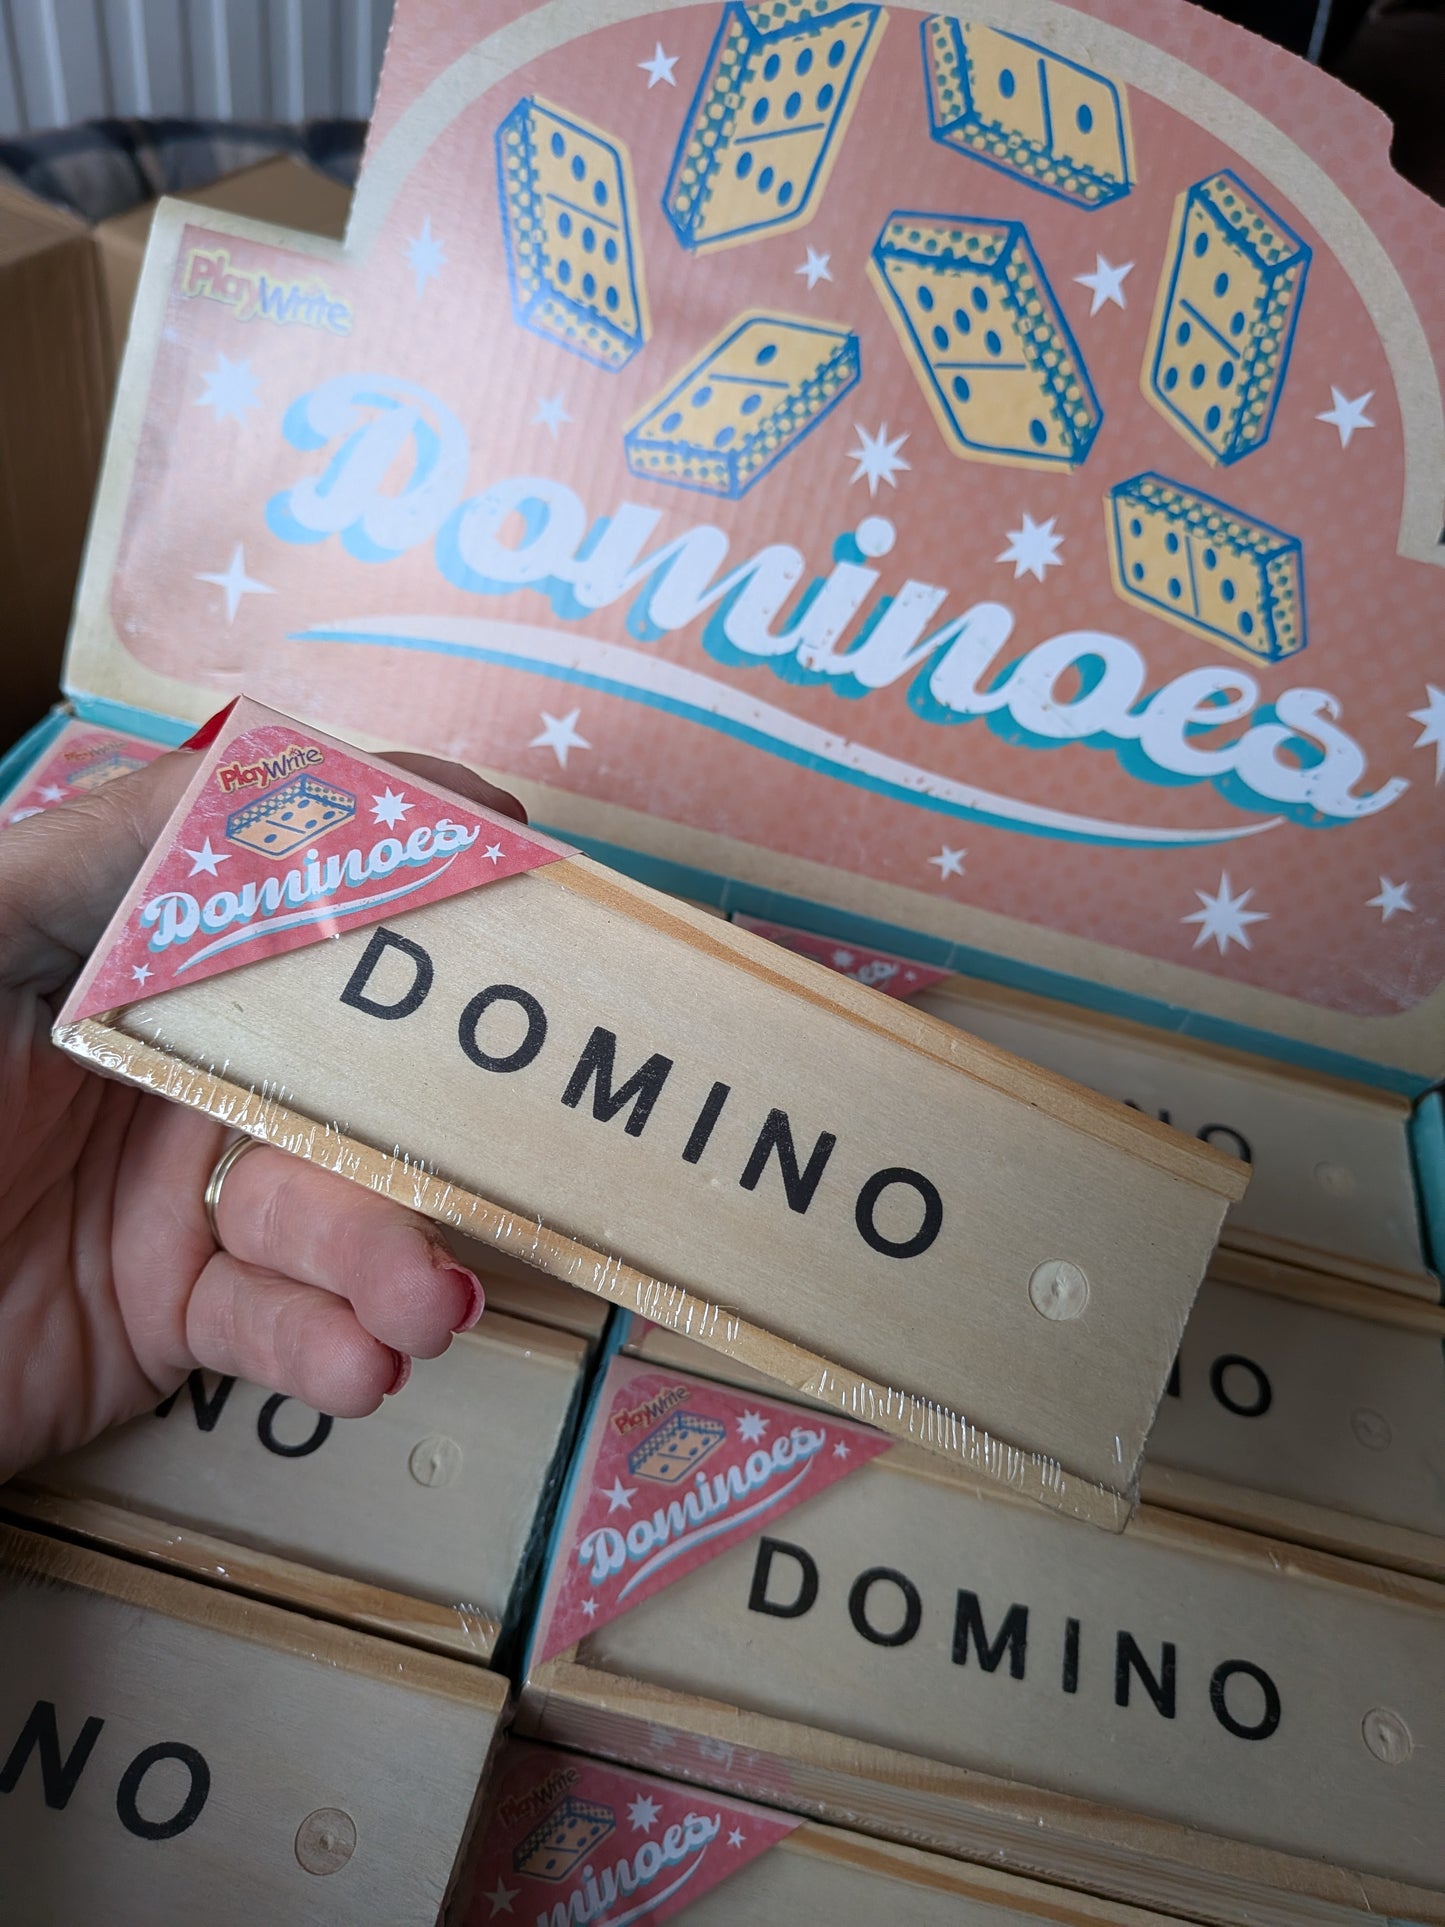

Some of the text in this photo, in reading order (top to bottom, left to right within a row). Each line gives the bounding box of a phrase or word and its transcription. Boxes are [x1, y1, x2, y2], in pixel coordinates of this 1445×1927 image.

[266, 373, 1409, 829] Dominoes
[219, 745, 325, 793] PlayWrite
[140, 818, 481, 952] Dominoes
[340, 926, 944, 1259] DOMINO
[612, 1386, 689, 1435] PlayWrite
[578, 1426, 826, 1586] Dominoes
[747, 1535, 1282, 1741] DOMINO
